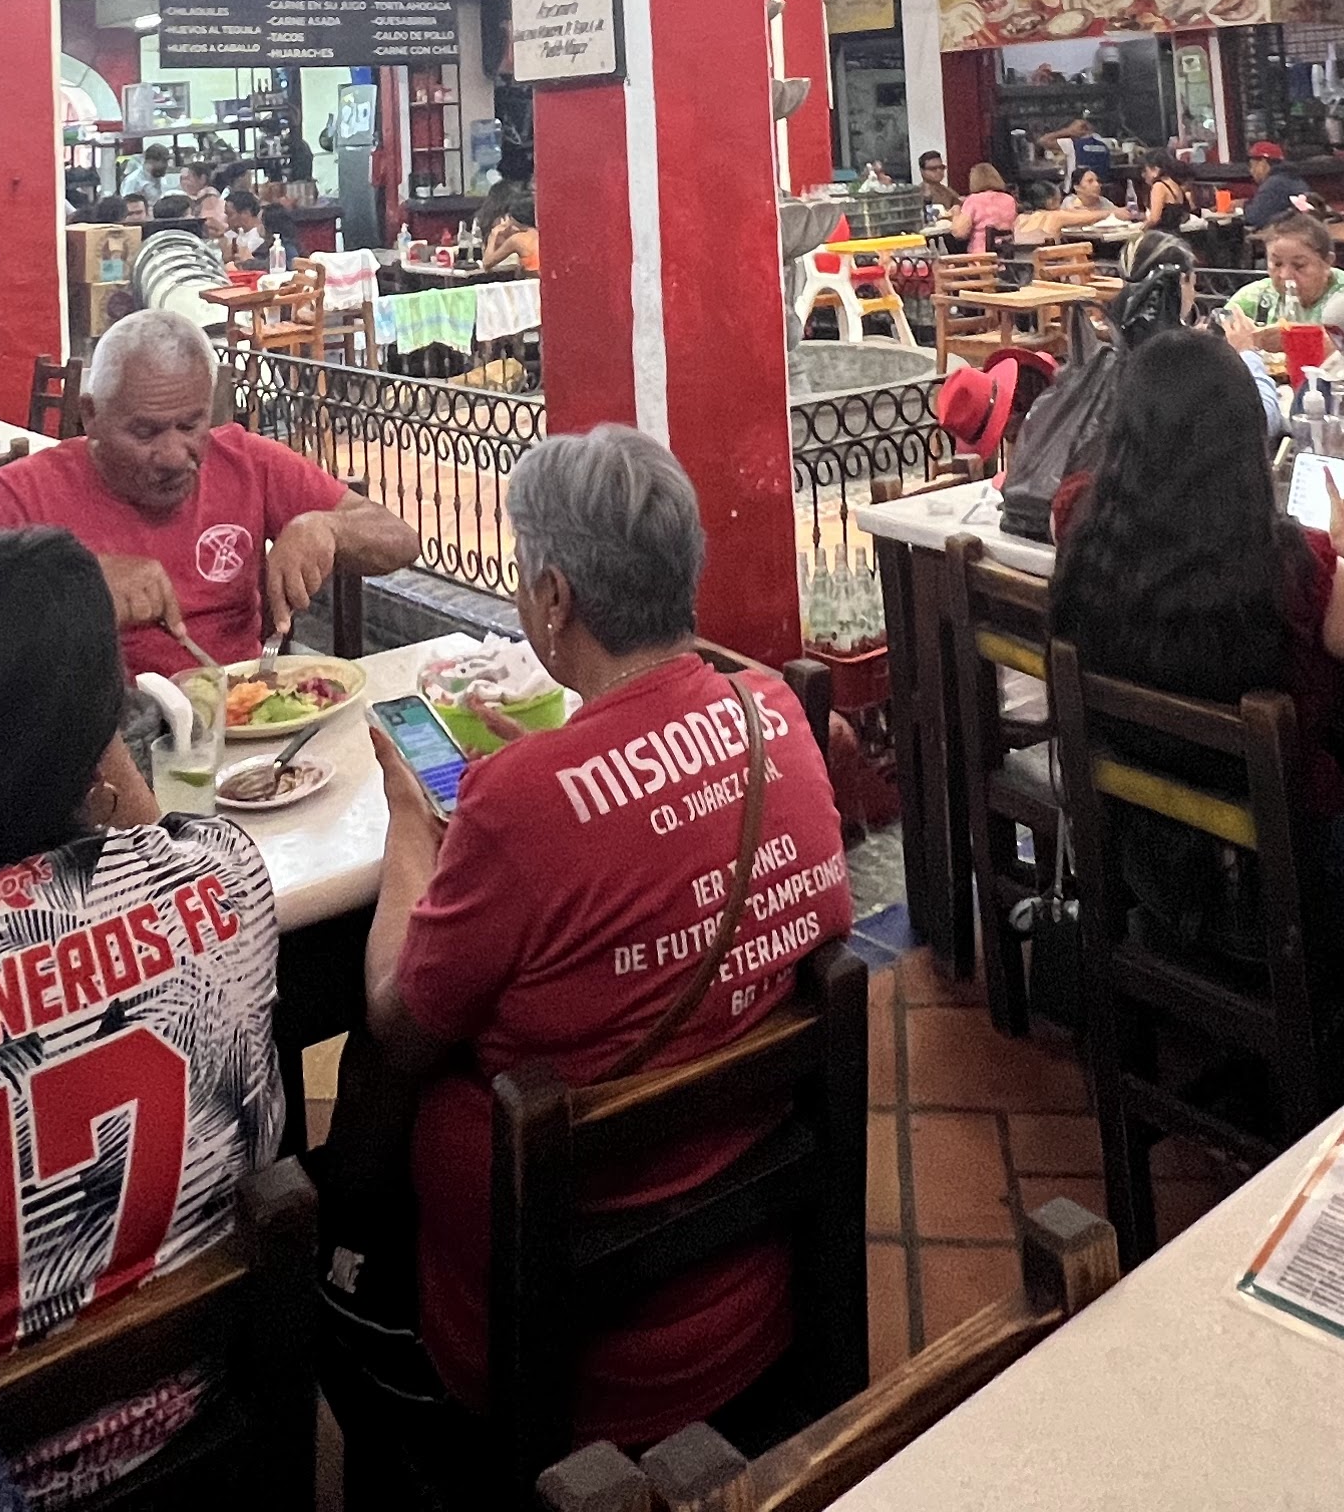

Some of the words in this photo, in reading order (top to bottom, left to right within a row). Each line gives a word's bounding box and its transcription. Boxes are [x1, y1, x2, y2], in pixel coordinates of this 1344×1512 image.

[307, 16, 342, 26] ASADA
[409, 31, 422, 41] DE
[424, 31, 455, 41] POLLO
[409, 45, 431, 56] CON
[650, 804, 684, 835] CD.
[682, 772, 744, 822] JUÁREZ
[175, 874, 241, 957] FC
[614, 943, 648, 976] DE
[709, 911, 821, 987] ETERANOS
